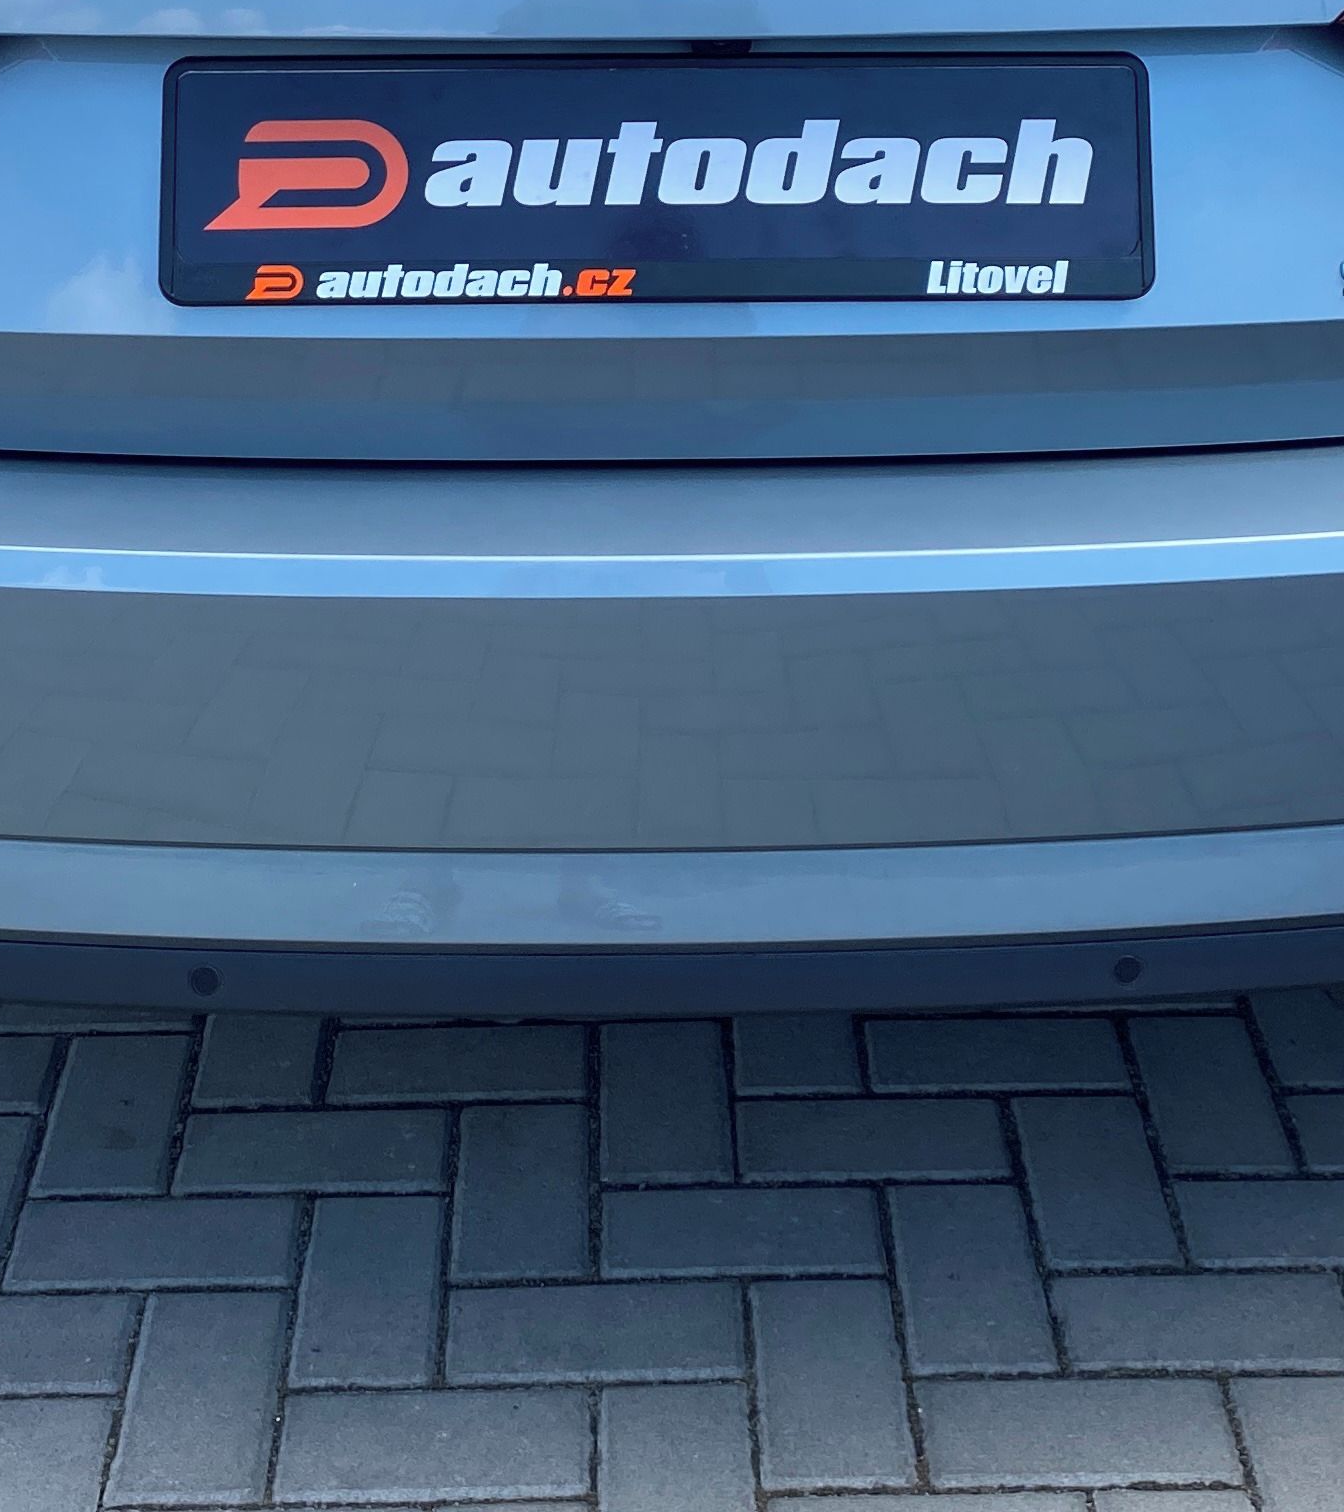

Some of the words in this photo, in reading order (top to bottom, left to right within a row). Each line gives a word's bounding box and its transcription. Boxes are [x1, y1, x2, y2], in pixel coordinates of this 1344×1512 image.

[424, 119, 1094, 208] autodach
[316, 263, 637, 299] autodach.cz
[926, 260, 1070, 294] Litovel
